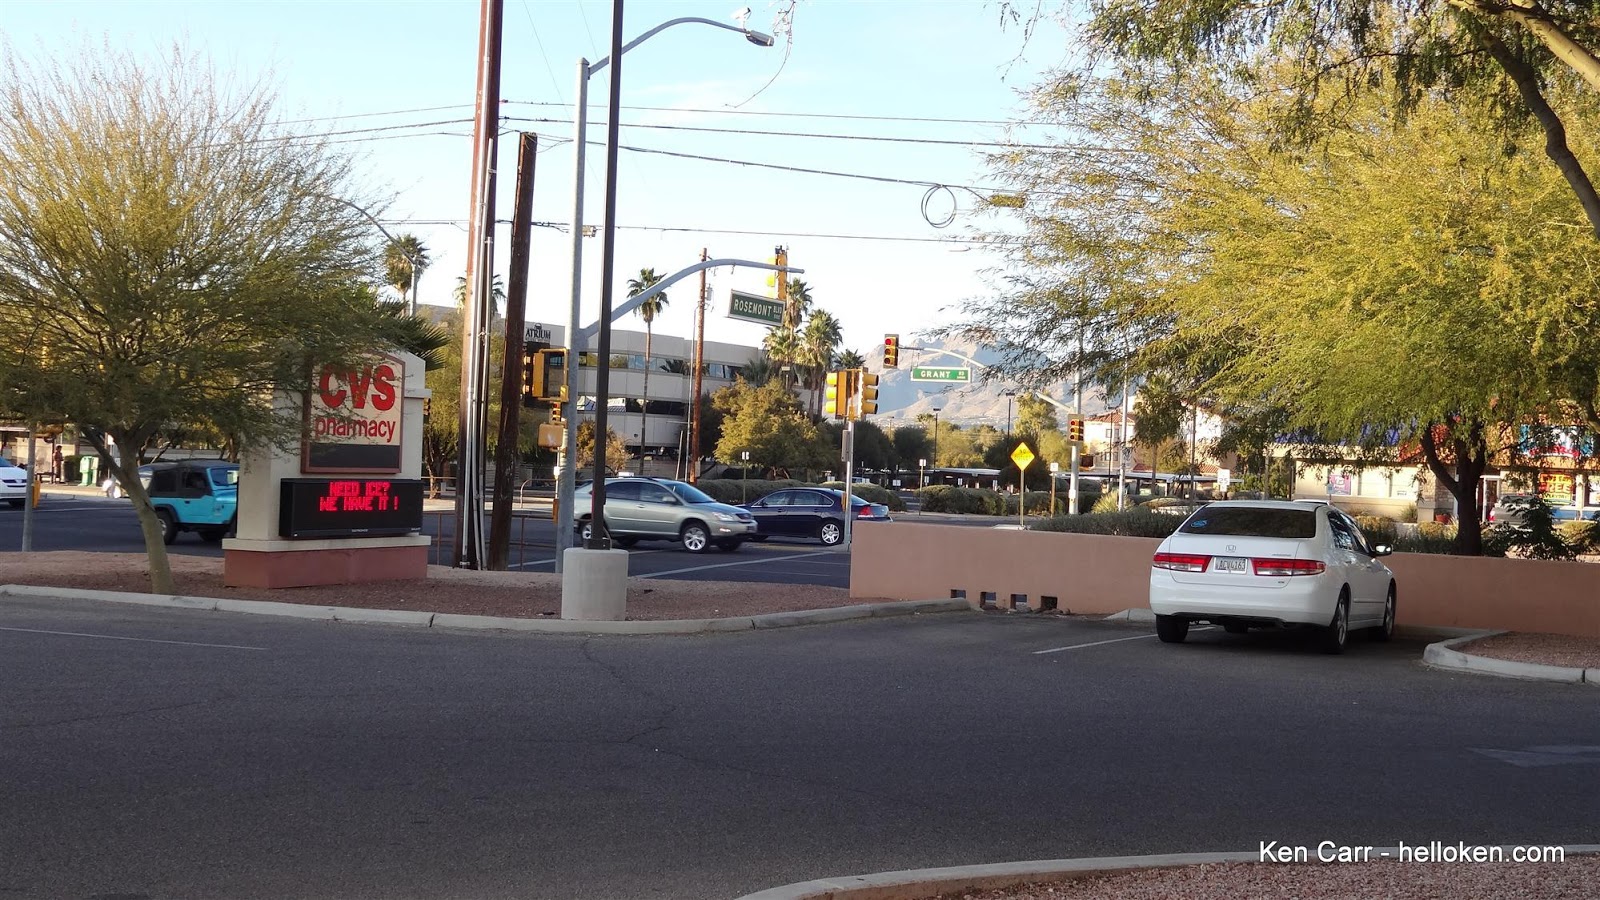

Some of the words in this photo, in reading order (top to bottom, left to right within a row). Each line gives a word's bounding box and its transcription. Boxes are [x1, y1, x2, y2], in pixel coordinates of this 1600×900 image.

[733, 299, 772, 317] ROSEMONT
[525, 328, 551, 340] ATRIUM
[920, 370, 951, 378] GRANT
[319, 363, 396, 411] CVS
[315, 416, 396, 443] pharmacy
[329, 481, 360, 496] NEED
[365, 481, 390, 496] ICE?
[320, 496, 338, 511] WE
[343, 496, 373, 511] HAVE
[378, 496, 389, 511] IT
